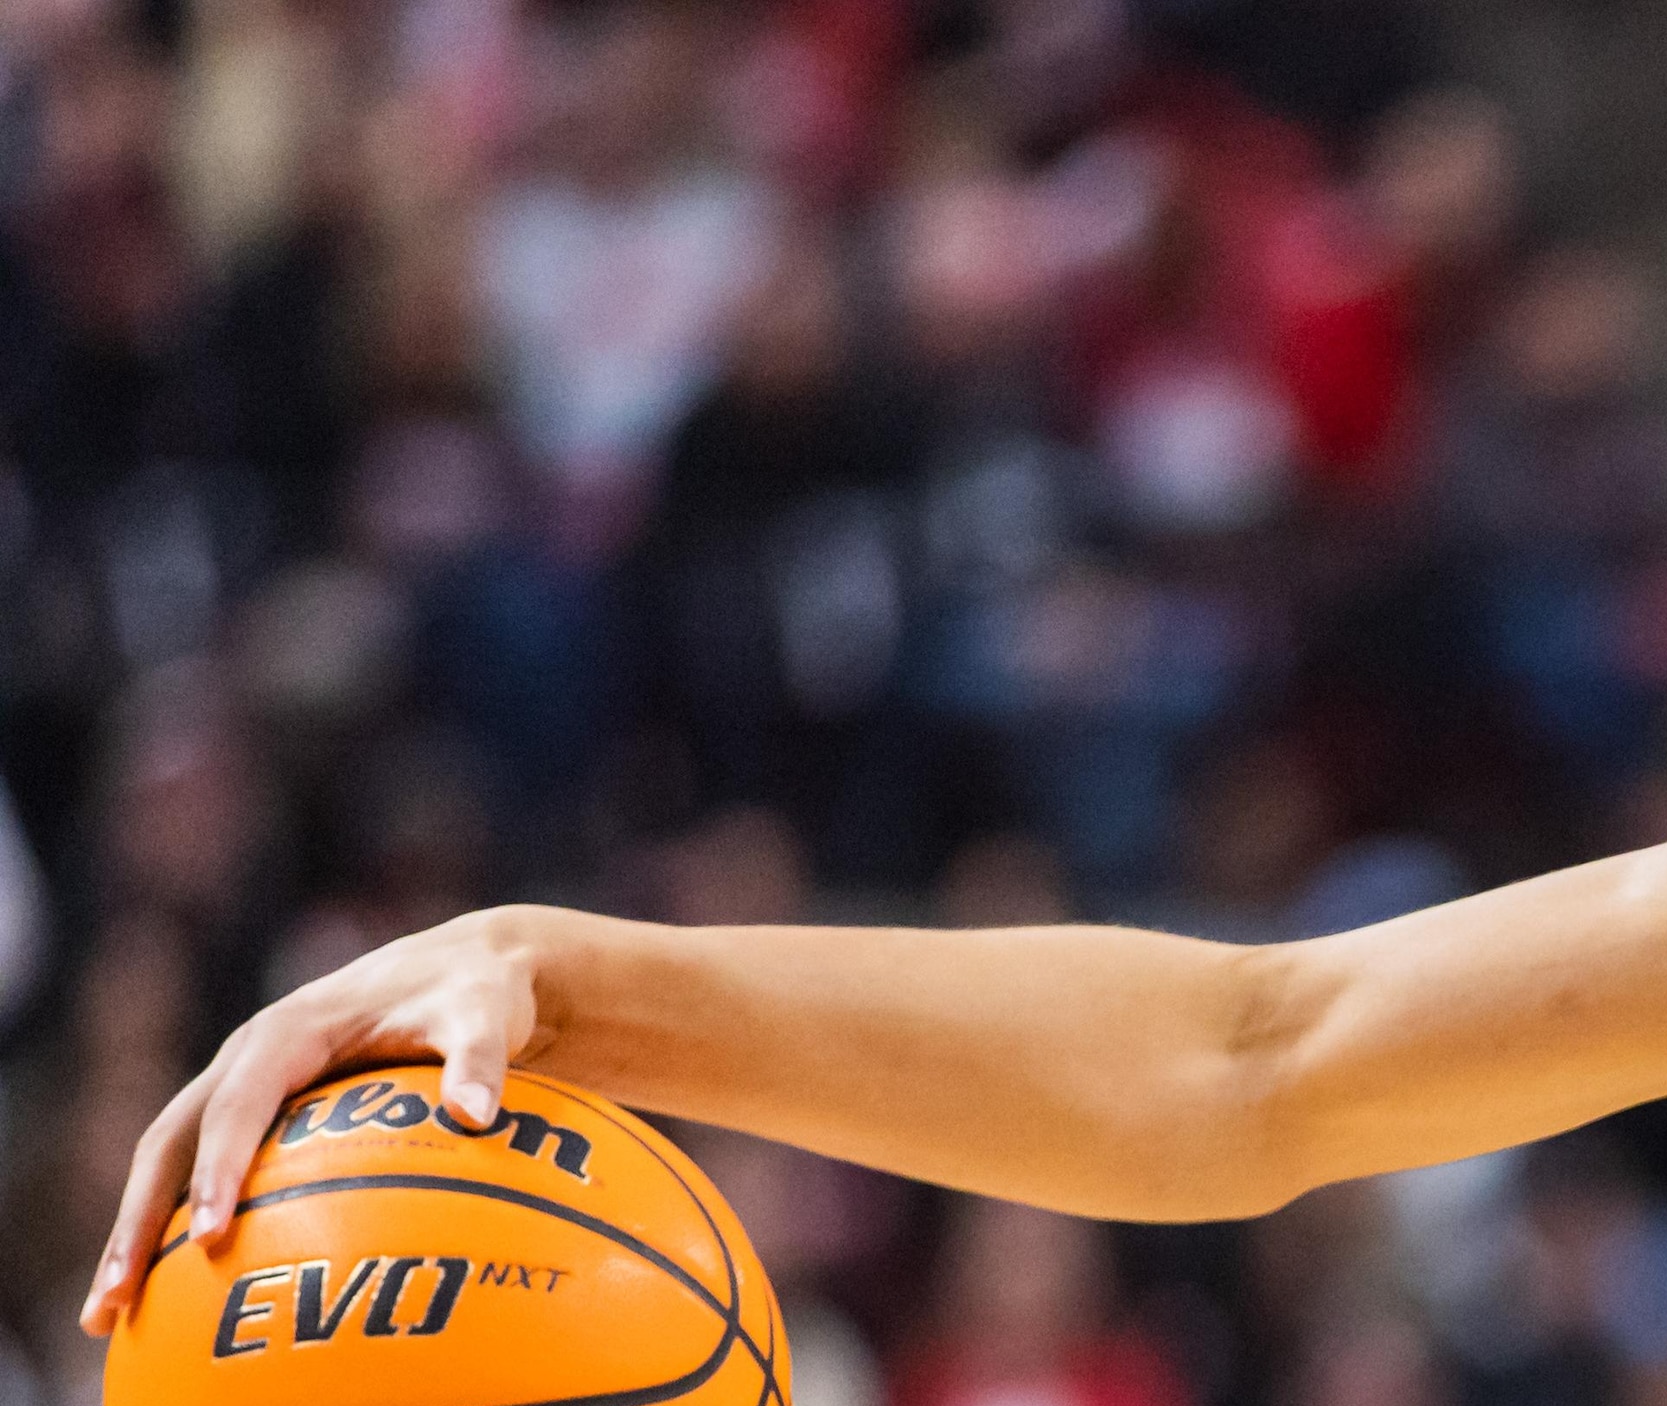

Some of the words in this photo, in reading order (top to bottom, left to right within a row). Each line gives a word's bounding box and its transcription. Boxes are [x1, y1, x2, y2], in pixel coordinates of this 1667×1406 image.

[279, 1081, 593, 1184] ilson
[212, 1256, 473, 1361] EVO
[479, 1262, 570, 1294] NXT
